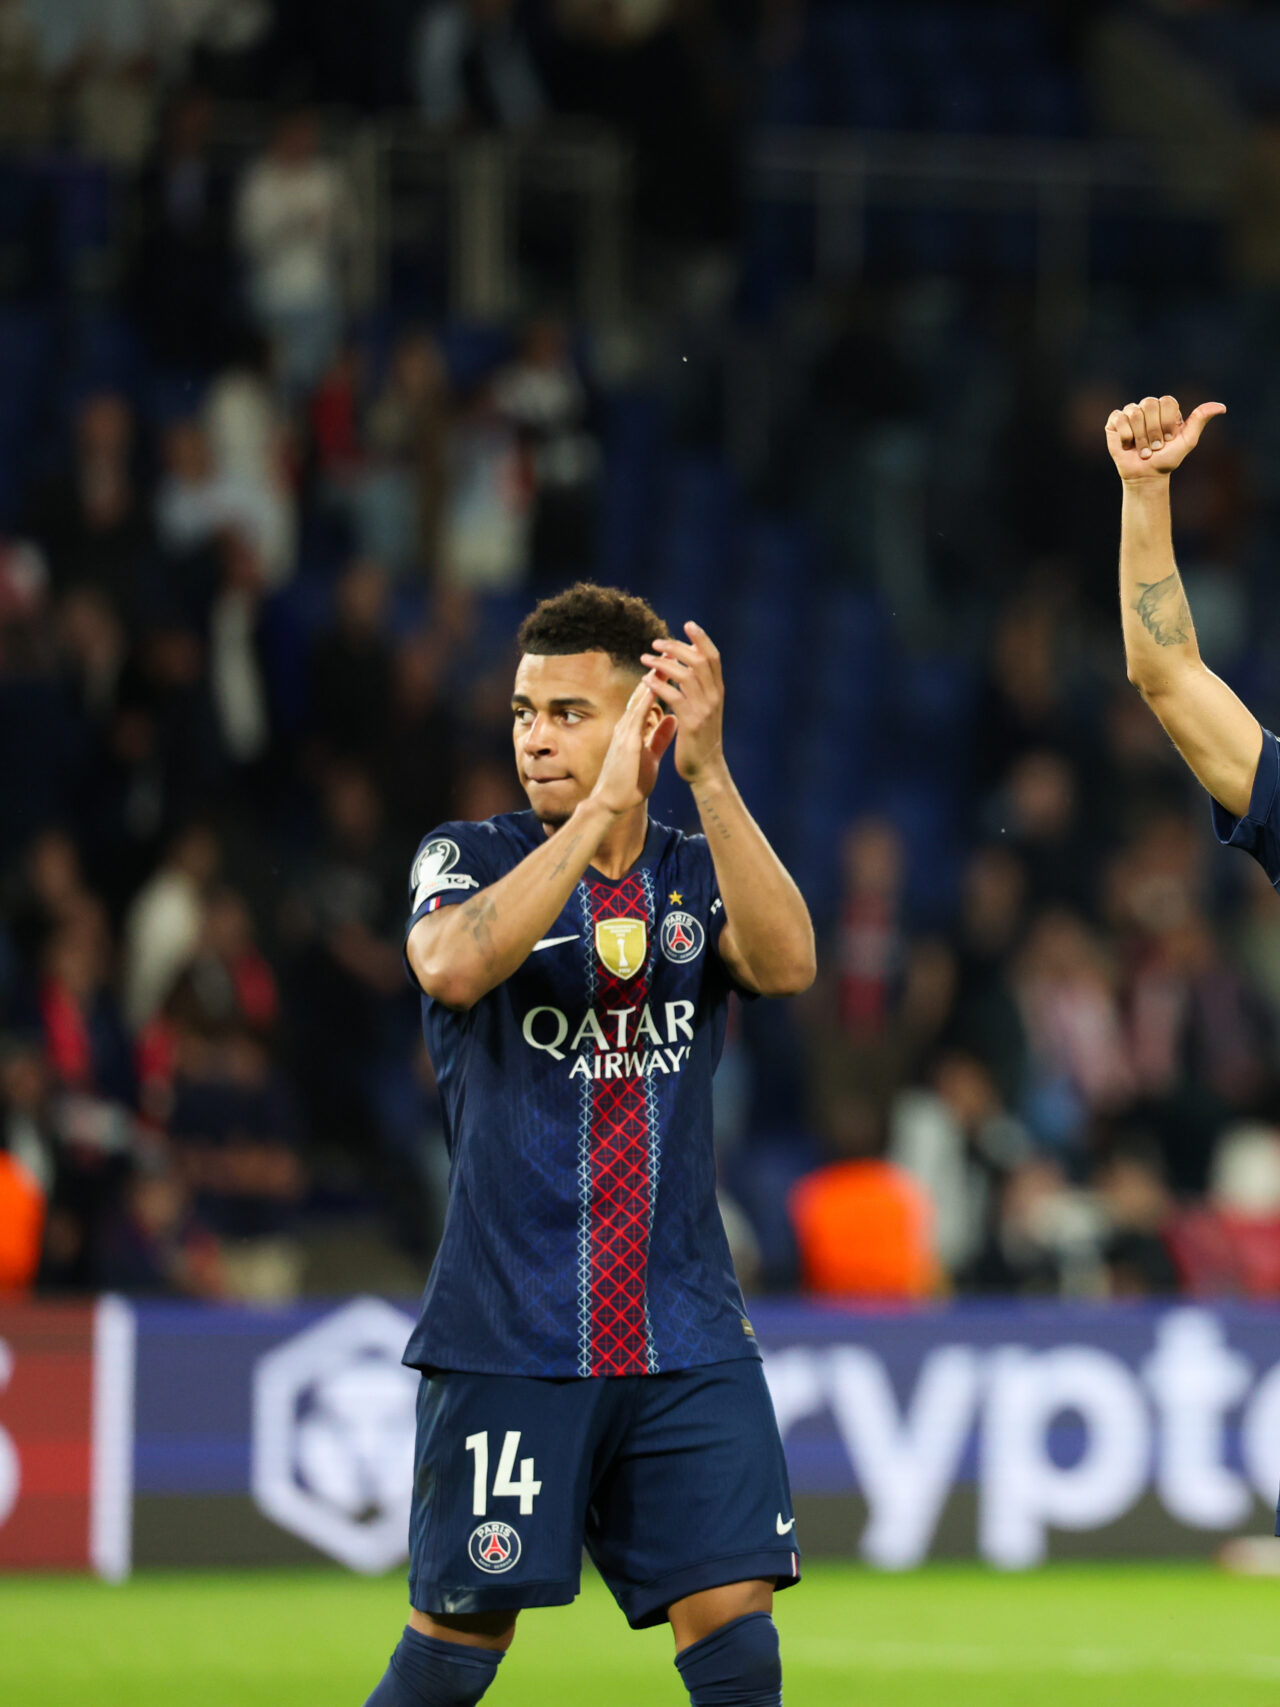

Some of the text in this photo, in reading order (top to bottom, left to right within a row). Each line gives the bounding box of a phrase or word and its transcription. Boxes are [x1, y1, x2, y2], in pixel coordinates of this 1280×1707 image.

[665, 913, 694, 928] PARIS
[522, 999, 695, 1061] QATAR
[568, 1045, 691, 1080] AIRWAY
[465, 1430, 542, 1516] 14
[476, 1524, 512, 1538] PARIS
